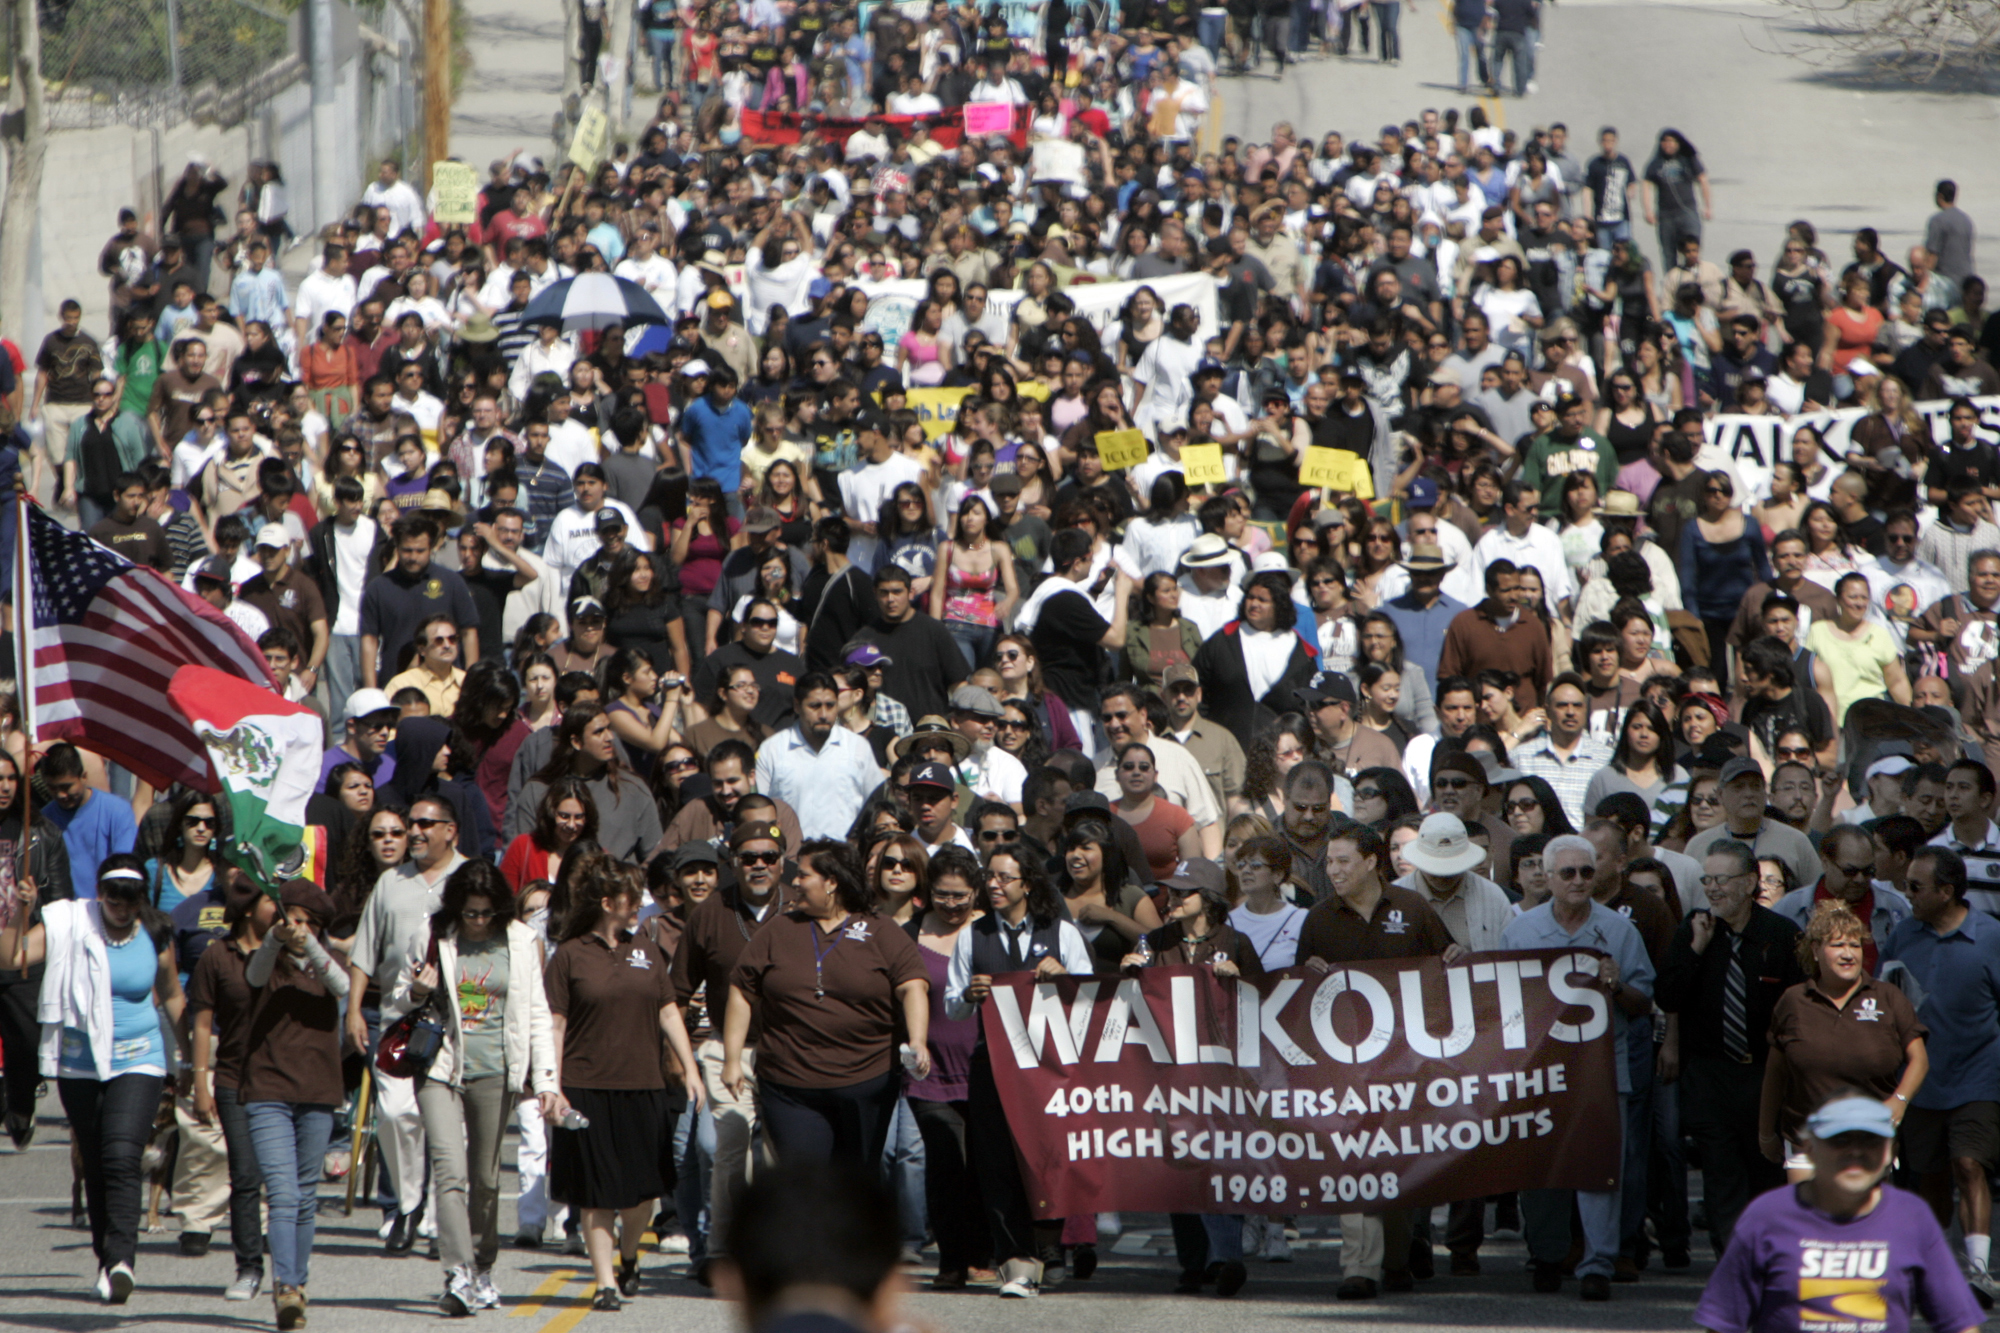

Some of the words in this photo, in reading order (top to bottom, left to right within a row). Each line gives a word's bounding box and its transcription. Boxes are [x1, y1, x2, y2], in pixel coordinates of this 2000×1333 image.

[1106, 447, 1142, 464] ICUC
[991, 953, 1608, 1069] WALKOUTS
[1045, 1084, 1133, 1117] 40th
[1144, 1081, 1417, 1119] ANNIVERSARY
[1426, 1074, 1480, 1107] OF
[1487, 1063, 1567, 1102] THE
[1067, 1127, 1163, 1162] HIGH
[1173, 1129, 1325, 1161] SCHOOL
[1330, 1108, 1553, 1161] WALKOUTS
[1210, 1173, 1287, 1203] 1968
[1321, 1171, 1399, 1202] 2008
[1799, 1249, 1889, 1279] SEIU
